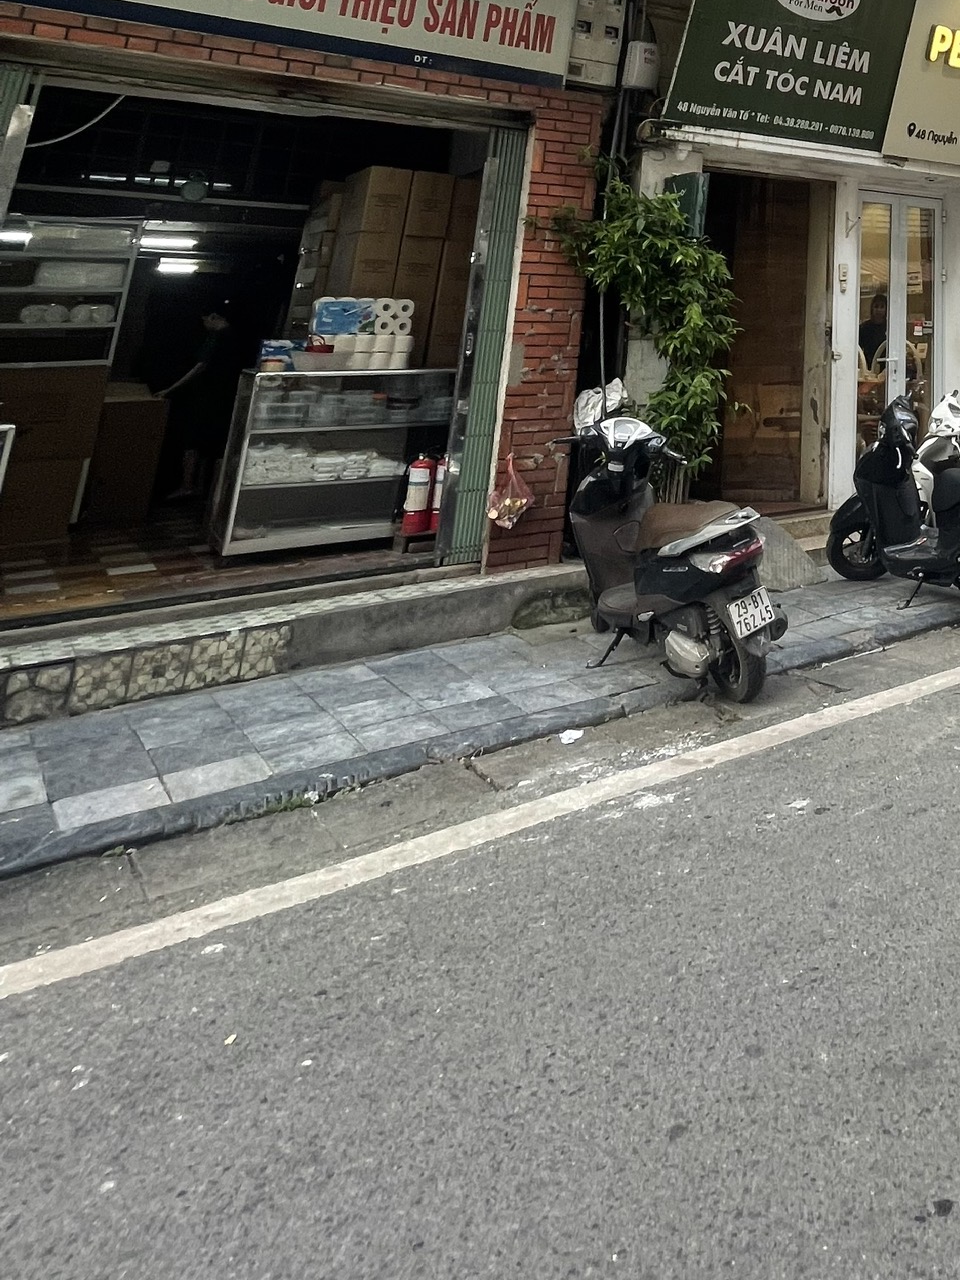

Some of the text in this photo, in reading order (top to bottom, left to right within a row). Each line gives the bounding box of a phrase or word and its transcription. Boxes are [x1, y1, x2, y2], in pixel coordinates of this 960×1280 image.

[805, 0, 823, 13] Men
[721, 20, 871, 74] XUÂN LIÊM
[714, 56, 863, 106] CẮT TÓC NAM
[677, 101, 689, 112] 48
[915, 129, 926, 139] 48
[735, 592, 765, 618] 29-B1
[737, 605, 773, 636] 762.45
